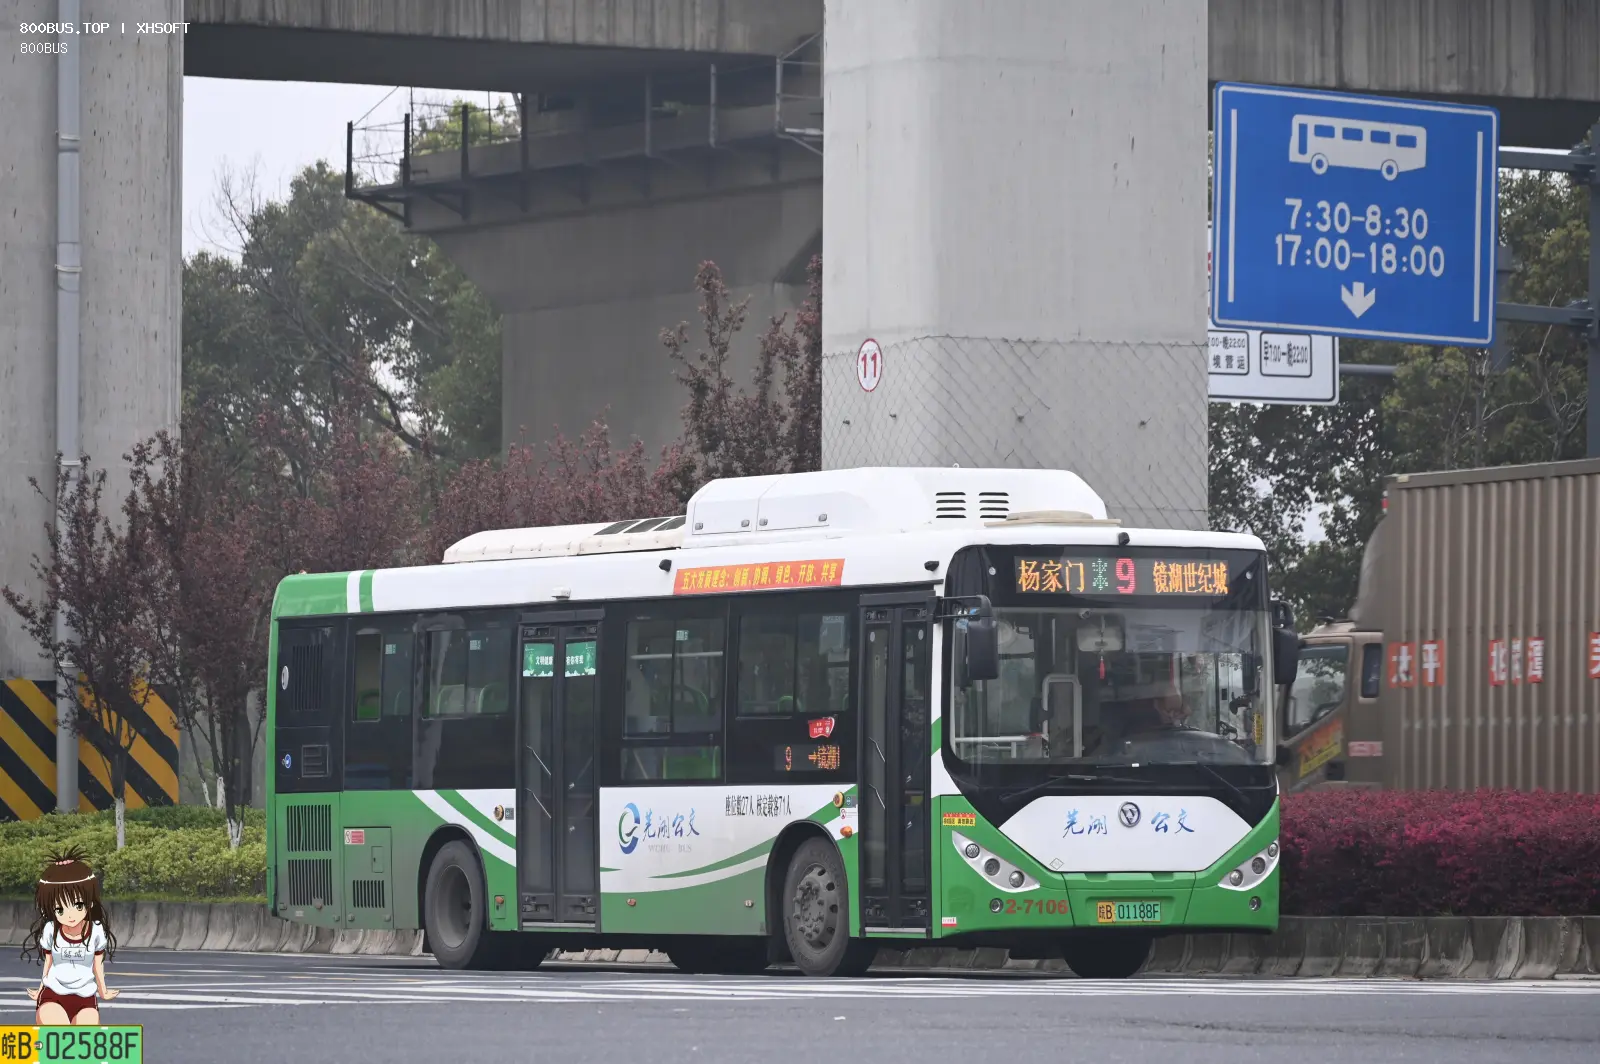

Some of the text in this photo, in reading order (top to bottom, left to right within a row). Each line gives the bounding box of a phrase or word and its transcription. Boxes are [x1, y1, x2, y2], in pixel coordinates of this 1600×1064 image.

[1284, 198, 1428, 240] 7:30-8:30
[1275, 234, 1445, 277] 17:00-18:00
[861, 353, 877, 378] 11
[1018, 558, 1229, 595] 杨家门 9 镜湖世纪城
[785, 746, 792, 771] 9
[642, 807, 701, 842] 芜湖公交
[1005, 899, 1069, 915] 2-7106
[1117, 904, 1160, 920] 01188F
